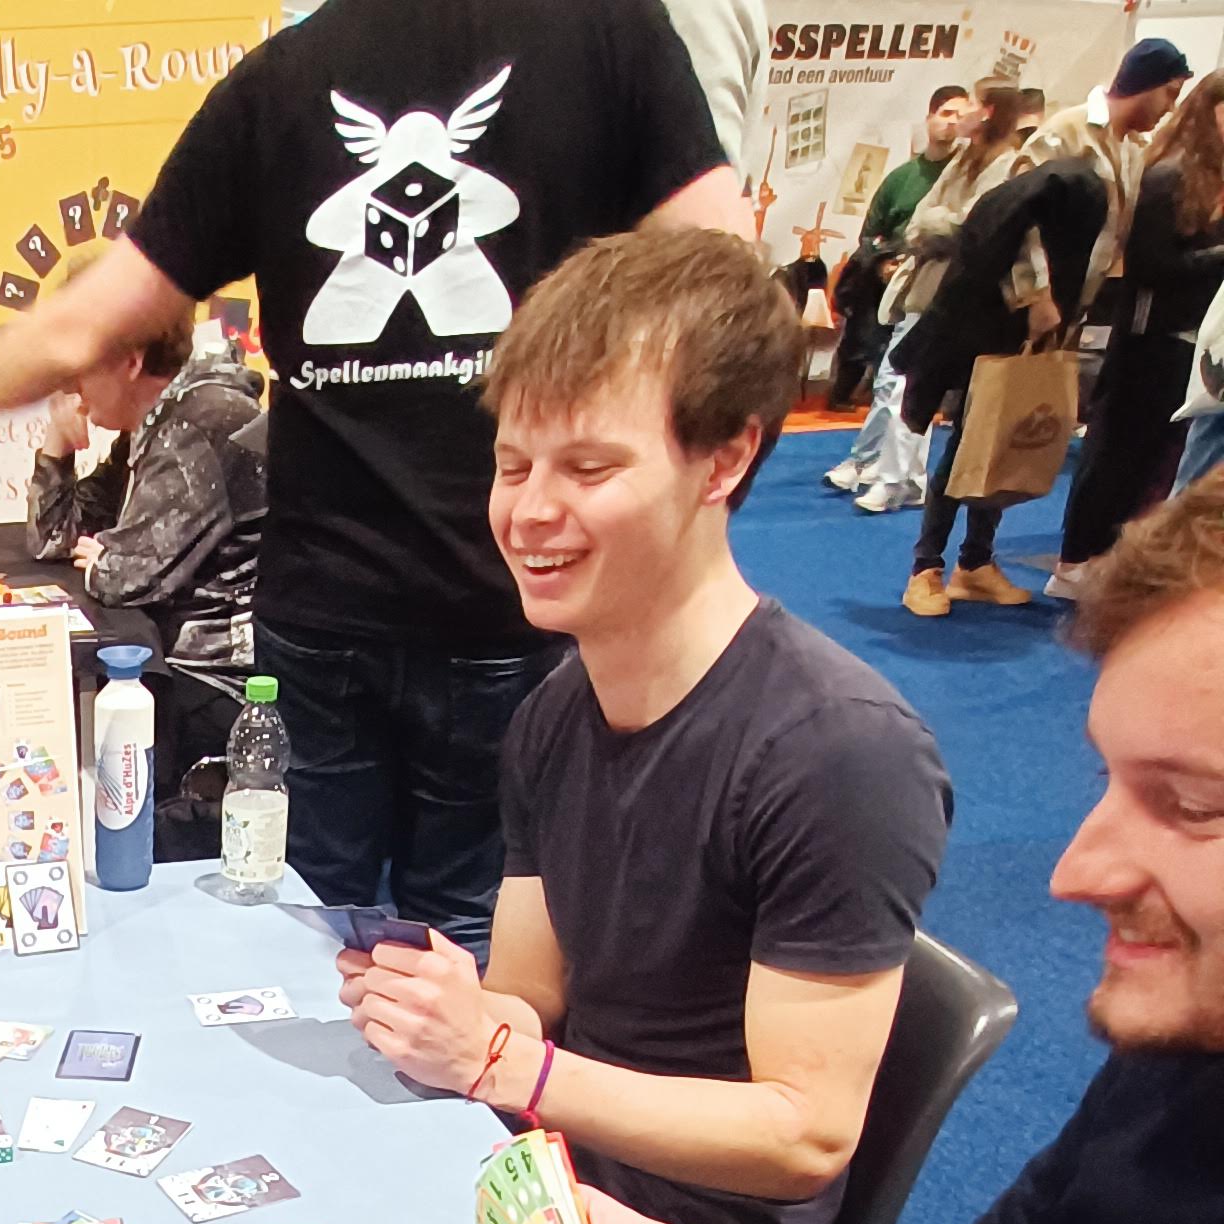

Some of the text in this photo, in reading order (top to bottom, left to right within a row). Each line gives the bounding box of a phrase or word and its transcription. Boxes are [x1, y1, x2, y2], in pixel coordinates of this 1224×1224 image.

[768, 23, 959, 60] SSPELLEN
[796, 68, 824, 84] een
[828, 65, 895, 83] avontuur
[124, 791, 136, 815] Alpe
[504, 1156, 520, 1182] 5
